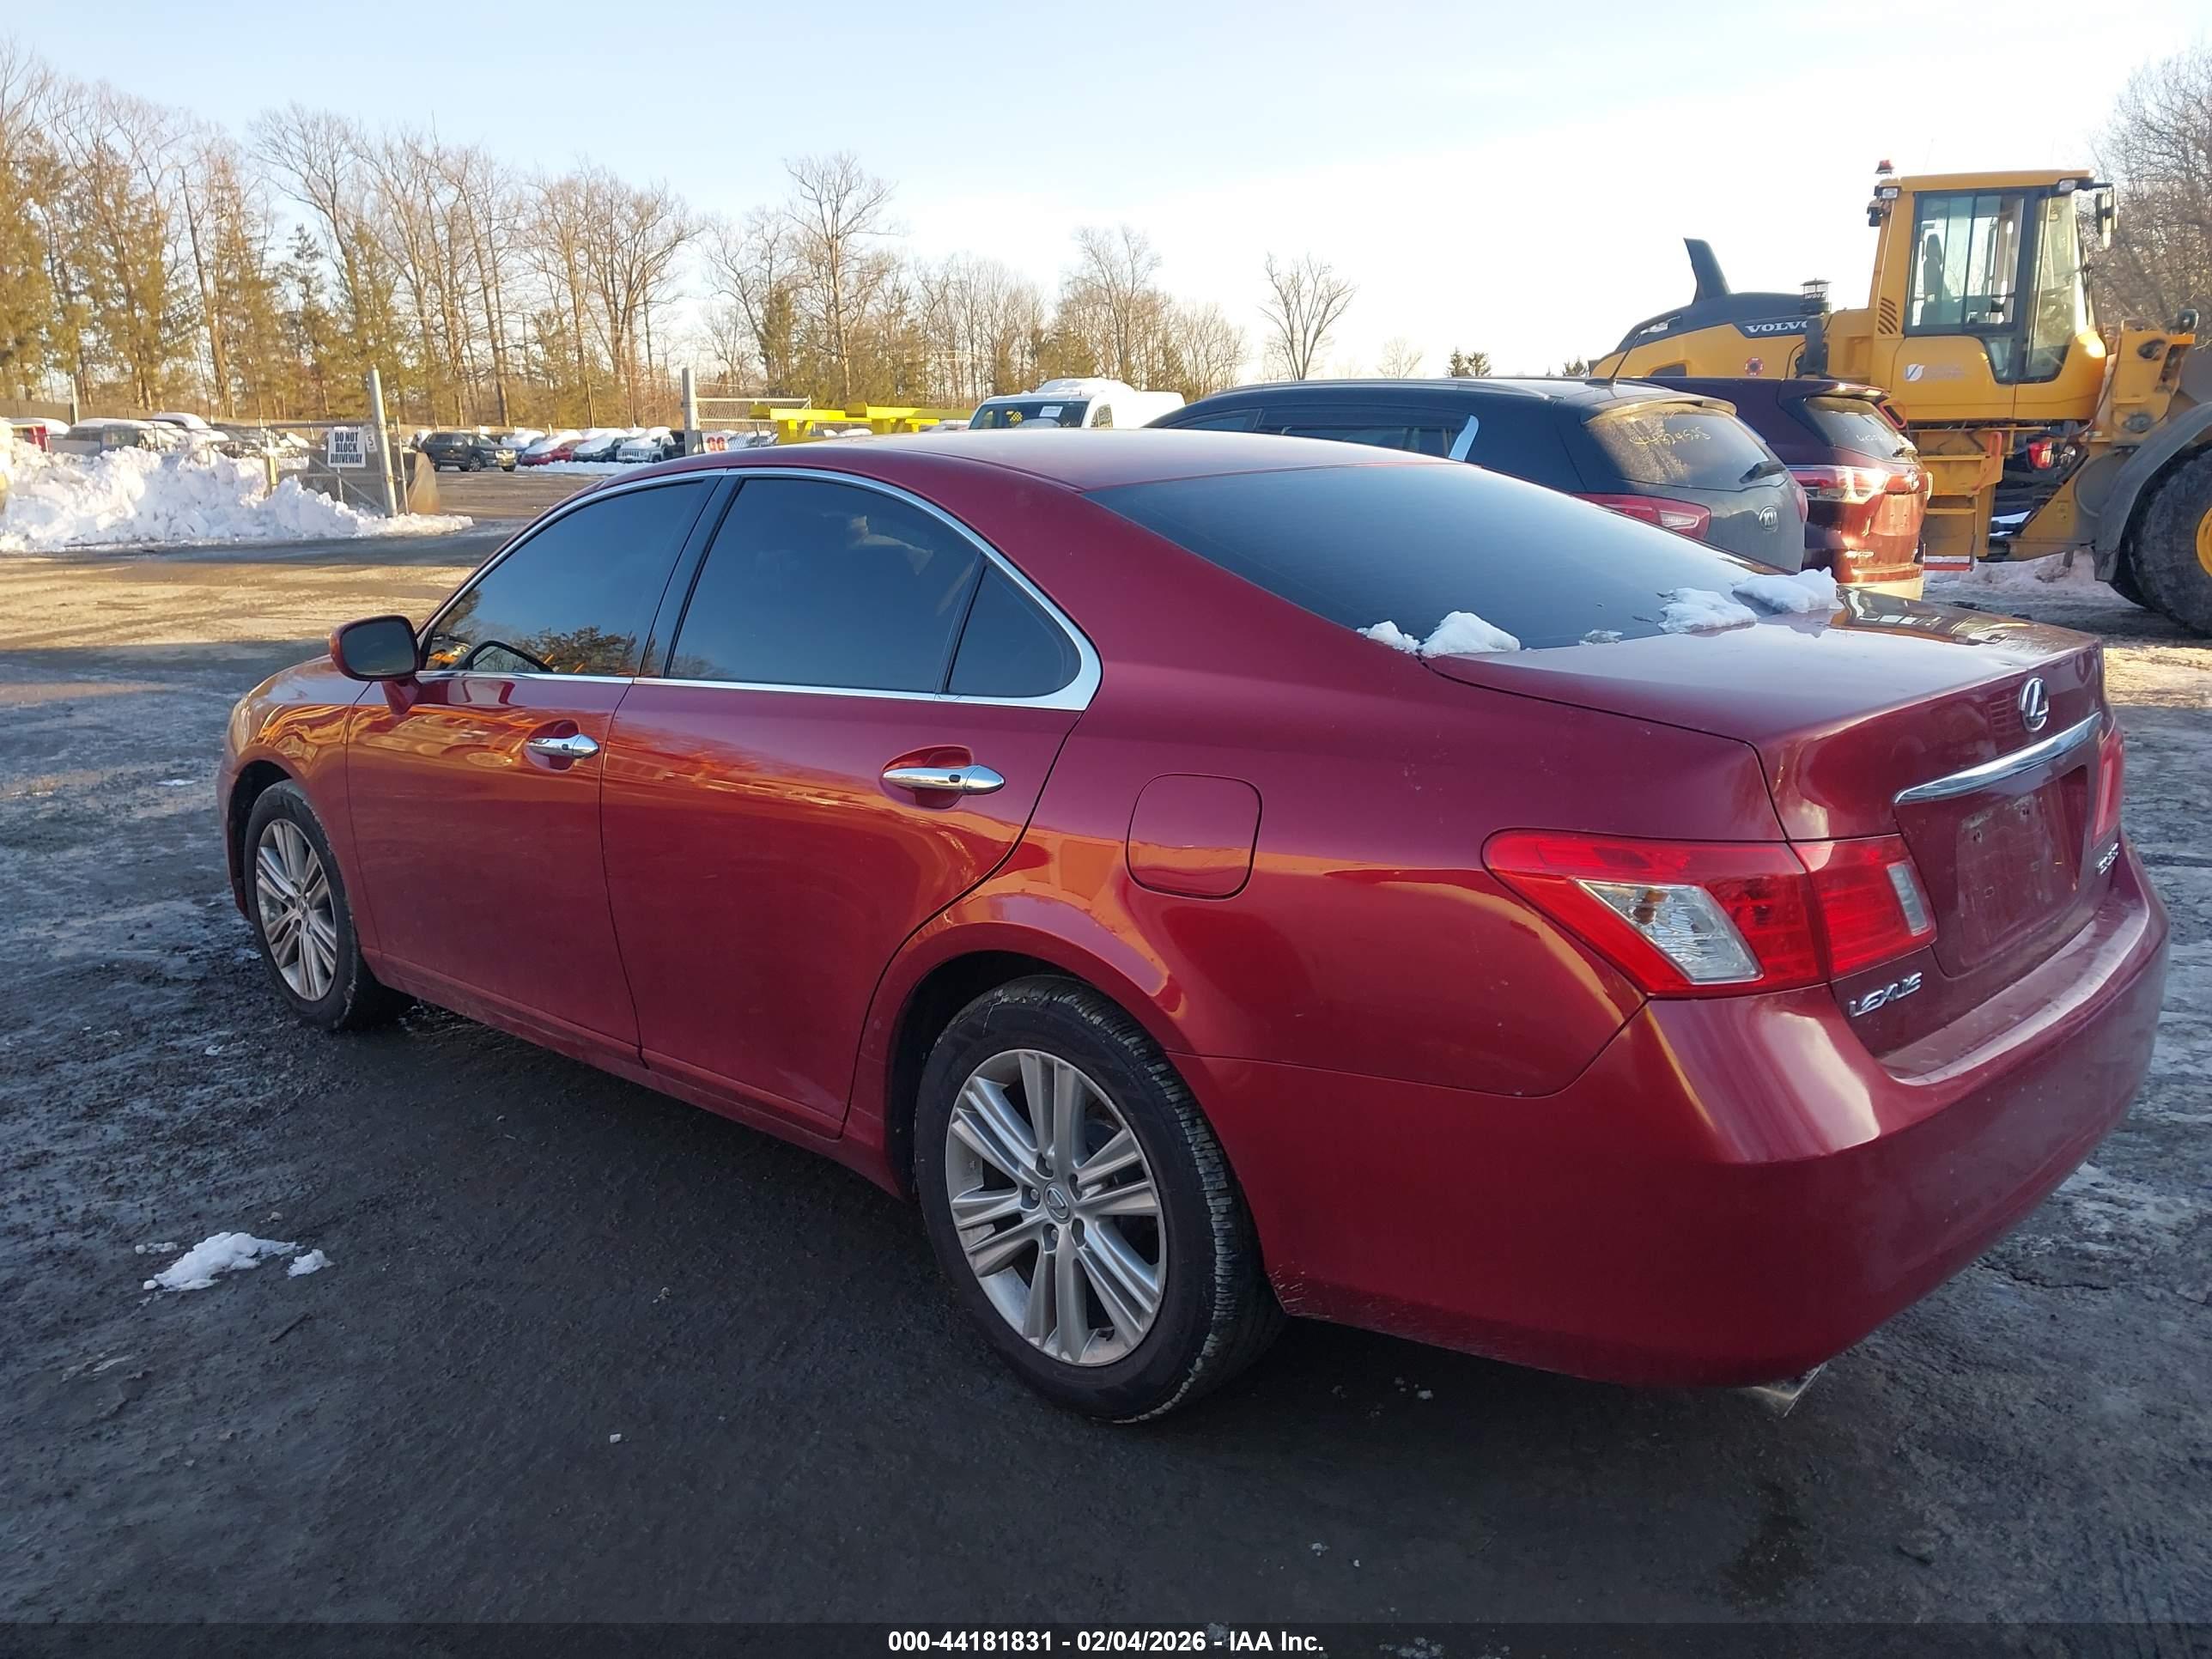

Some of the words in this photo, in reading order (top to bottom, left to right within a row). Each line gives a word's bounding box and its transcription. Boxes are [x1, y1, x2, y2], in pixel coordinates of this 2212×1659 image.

[335, 432, 343, 442] DO
[345, 432, 358, 442] NOT
[368, 435, 374, 447] 5
[336, 442, 358, 453] BLOCK
[331, 453, 362, 464] DRIVEWAY
[1849, 971, 1923, 1018] LEXUS
